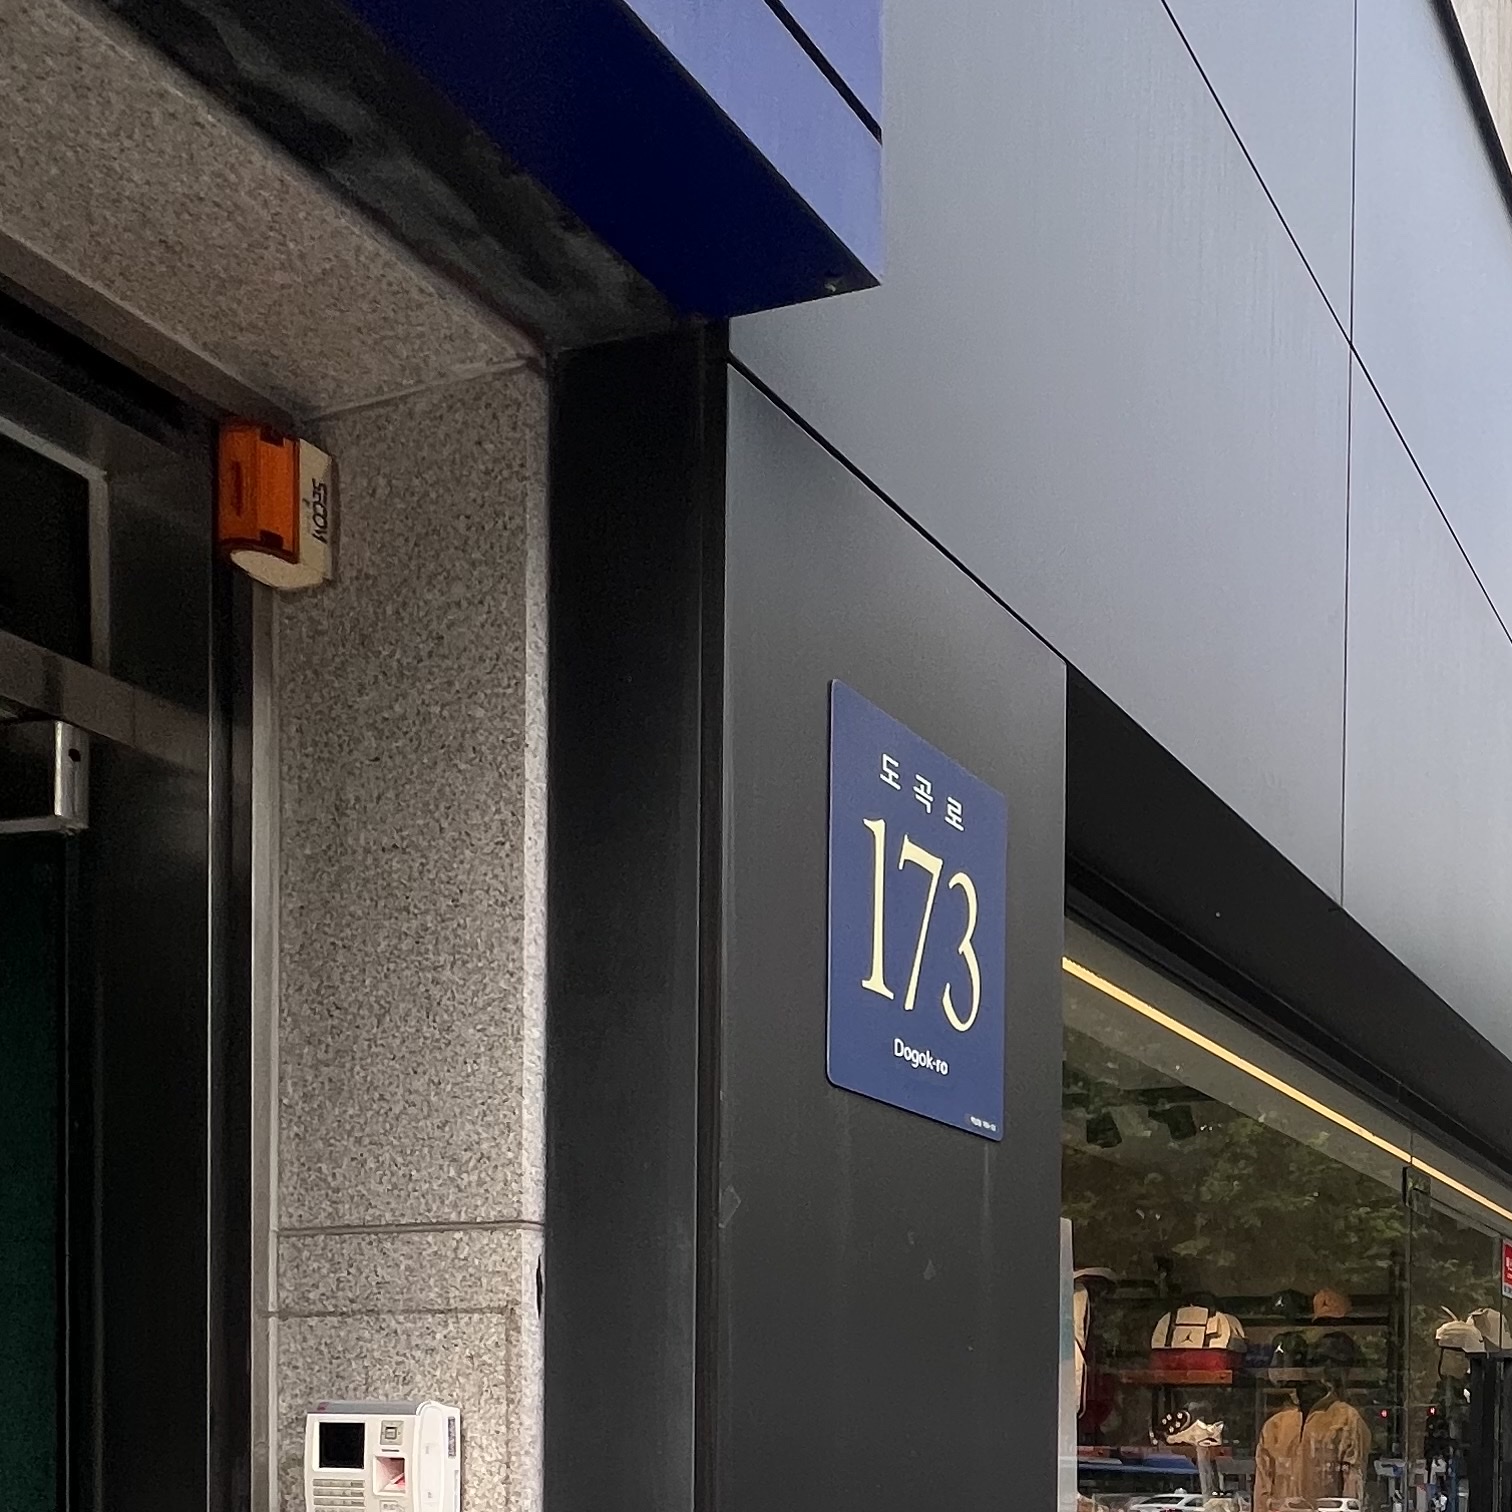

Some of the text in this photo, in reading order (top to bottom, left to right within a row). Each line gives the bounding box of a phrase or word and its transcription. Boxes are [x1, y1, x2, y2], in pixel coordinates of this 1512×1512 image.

[880, 753, 964, 831] 도곡로
[862, 817, 982, 1032] 173
[893, 1037, 949, 1076] Dogok-ro
